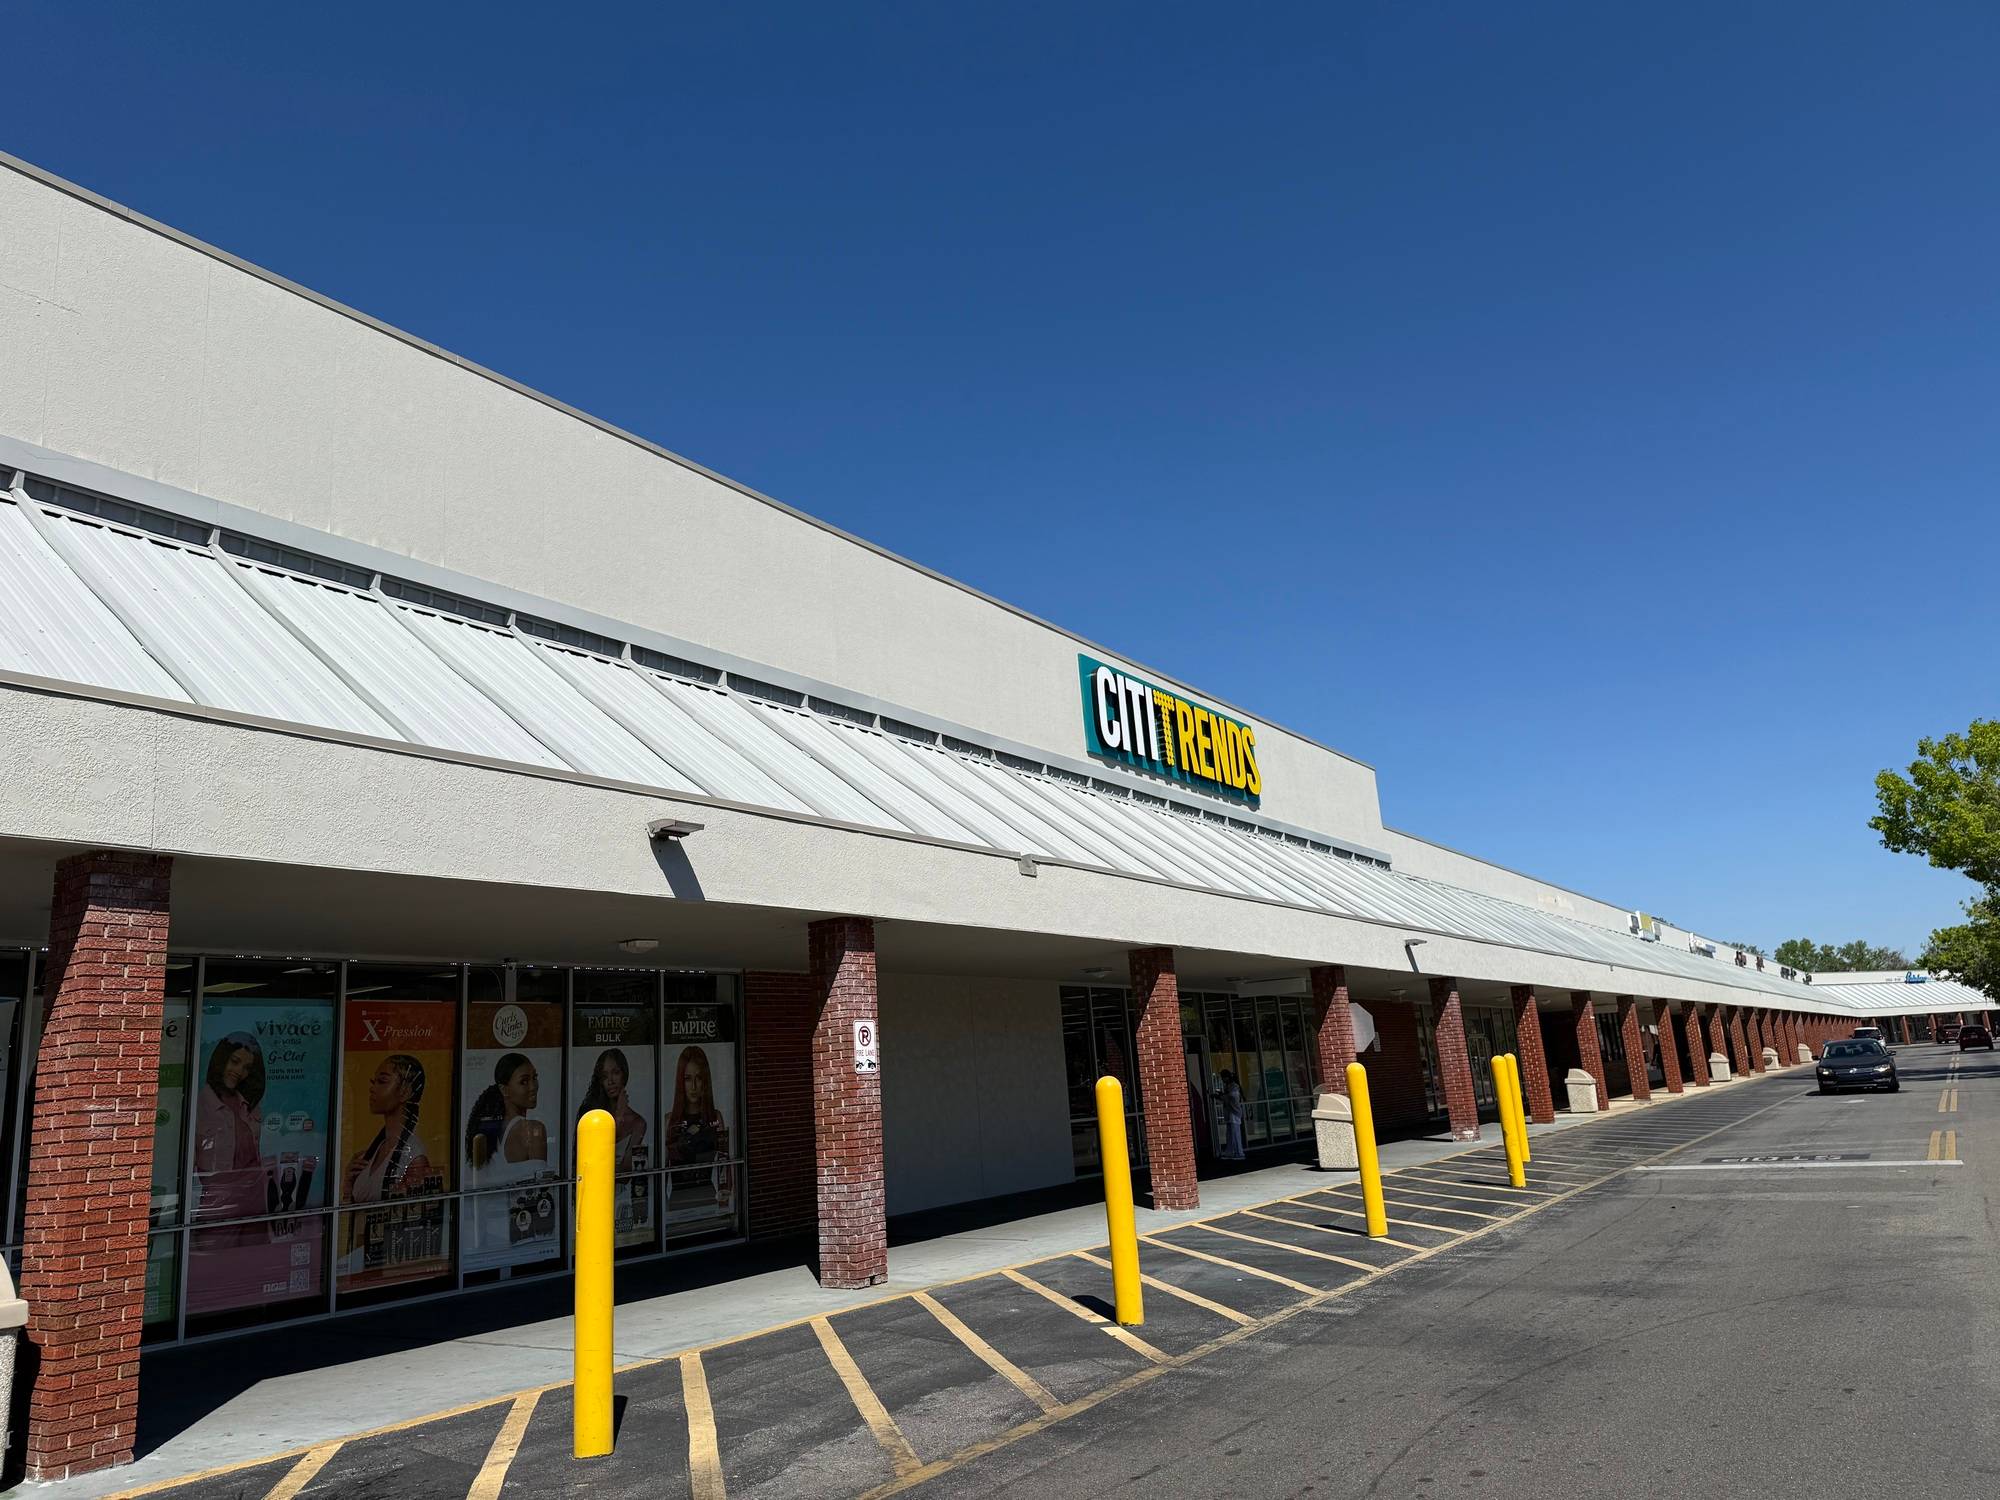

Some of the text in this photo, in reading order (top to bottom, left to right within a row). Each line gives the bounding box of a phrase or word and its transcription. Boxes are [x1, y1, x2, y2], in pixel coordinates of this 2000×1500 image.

[255, 1020, 322, 1036] Vivacé
[671, 1020, 717, 1037] EMPIRE
[594, 1033, 622, 1043] BULK
